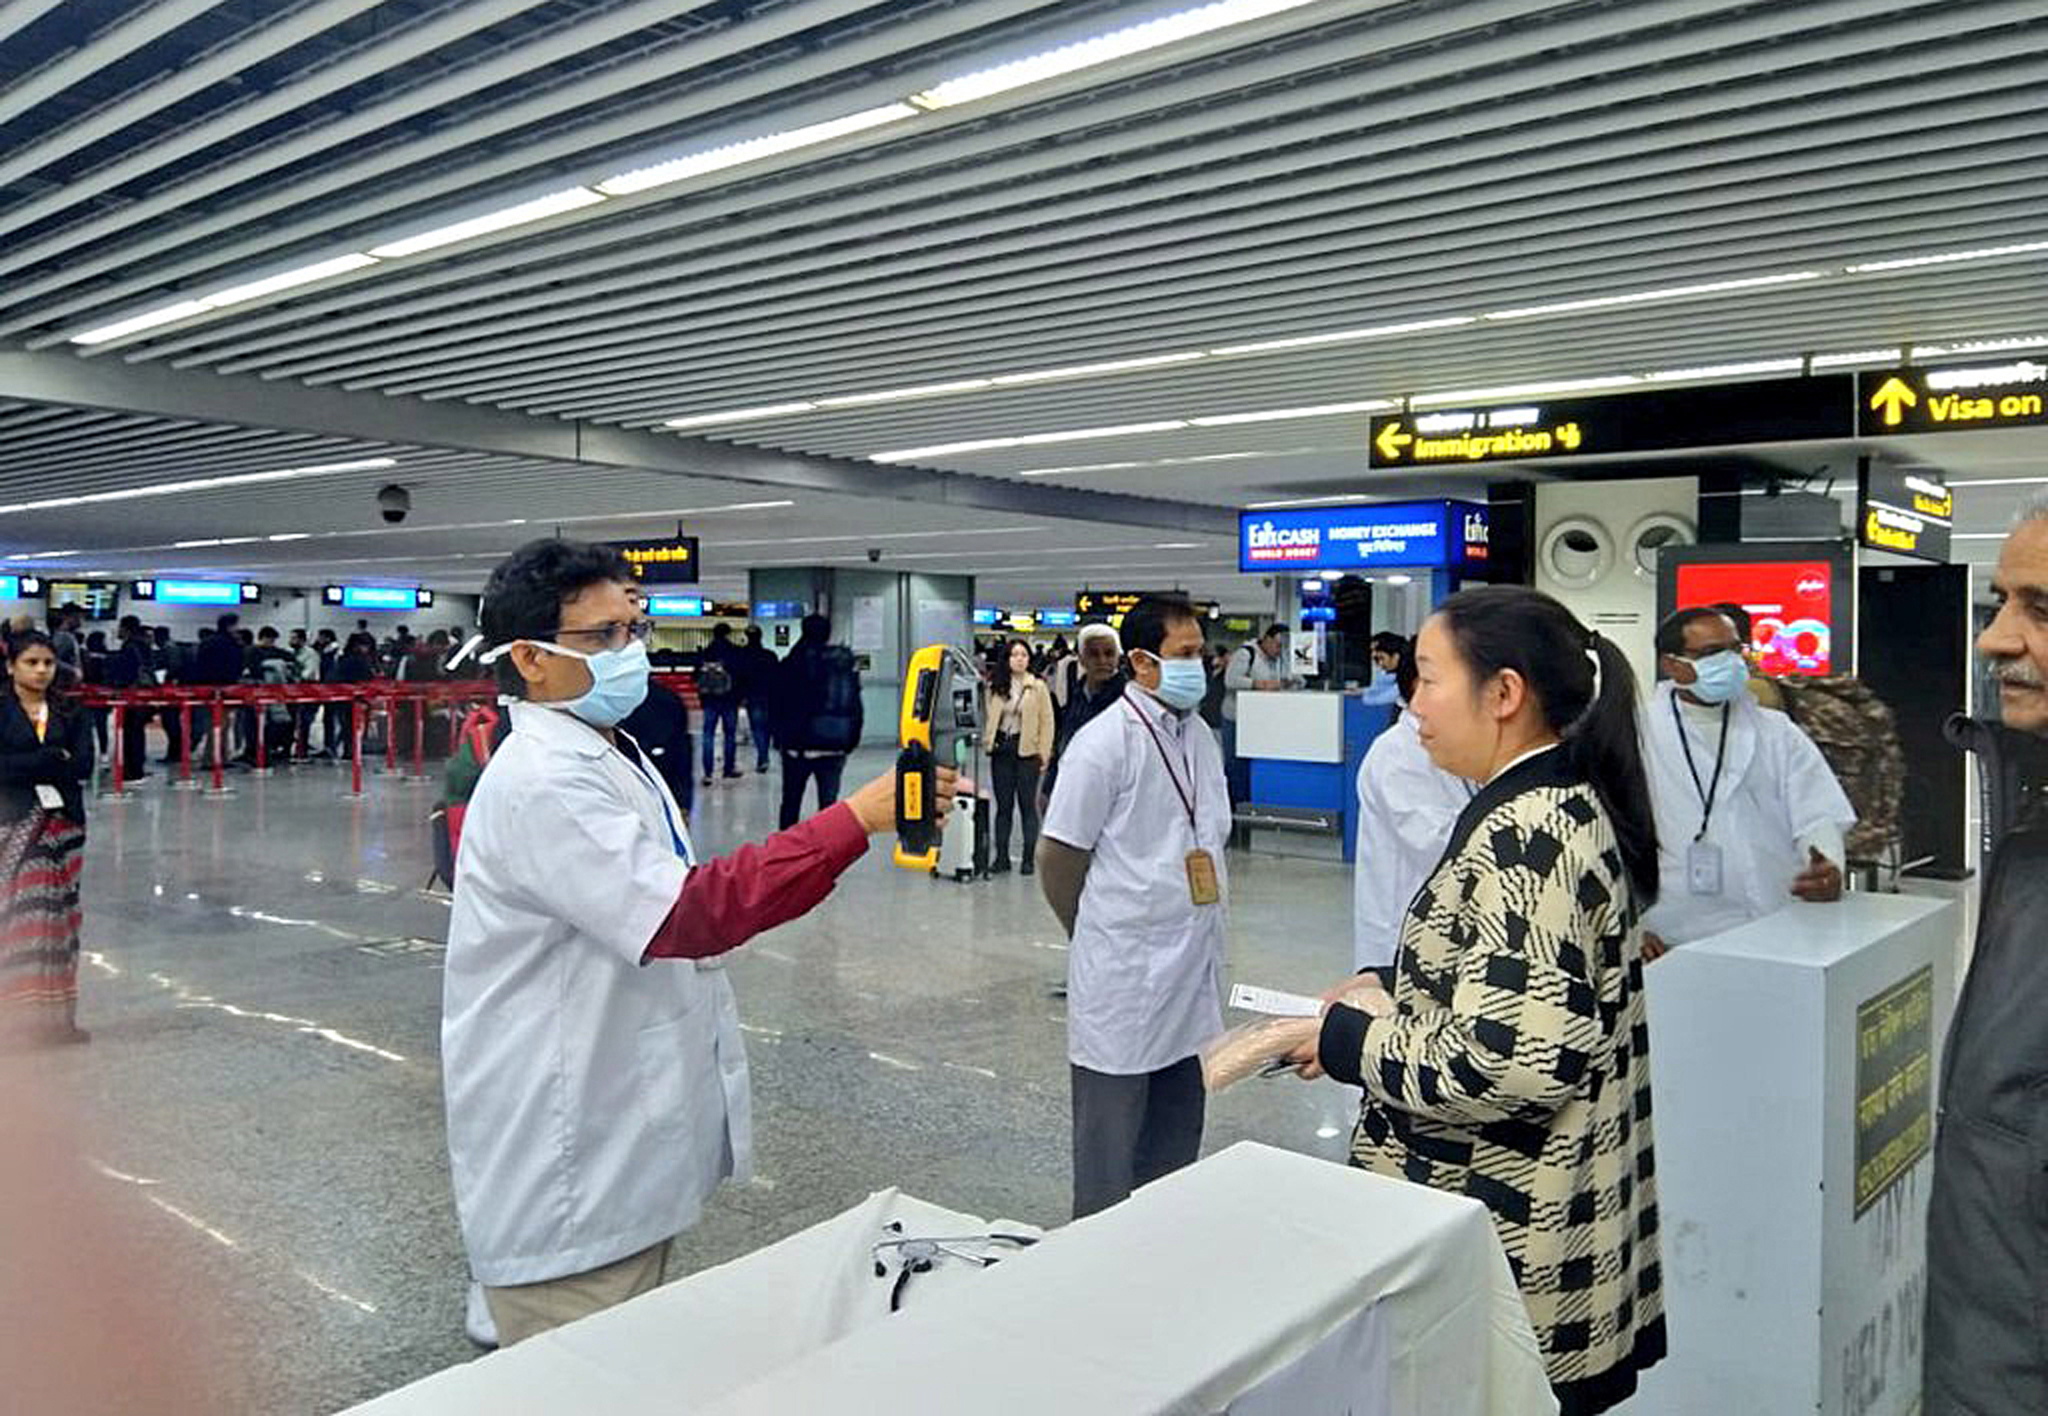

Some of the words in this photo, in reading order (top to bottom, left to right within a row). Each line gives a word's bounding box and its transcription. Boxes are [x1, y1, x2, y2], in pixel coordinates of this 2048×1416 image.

[1928, 394, 1994, 422] Visa
[2000, 395, 2042, 417] on
[1414, 428, 1551, 459] Immigration
[1328, 526, 1370, 540] MONEY
[1372, 522, 1437, 538] EXCHANGE
[136, 581, 152, 595] 11
